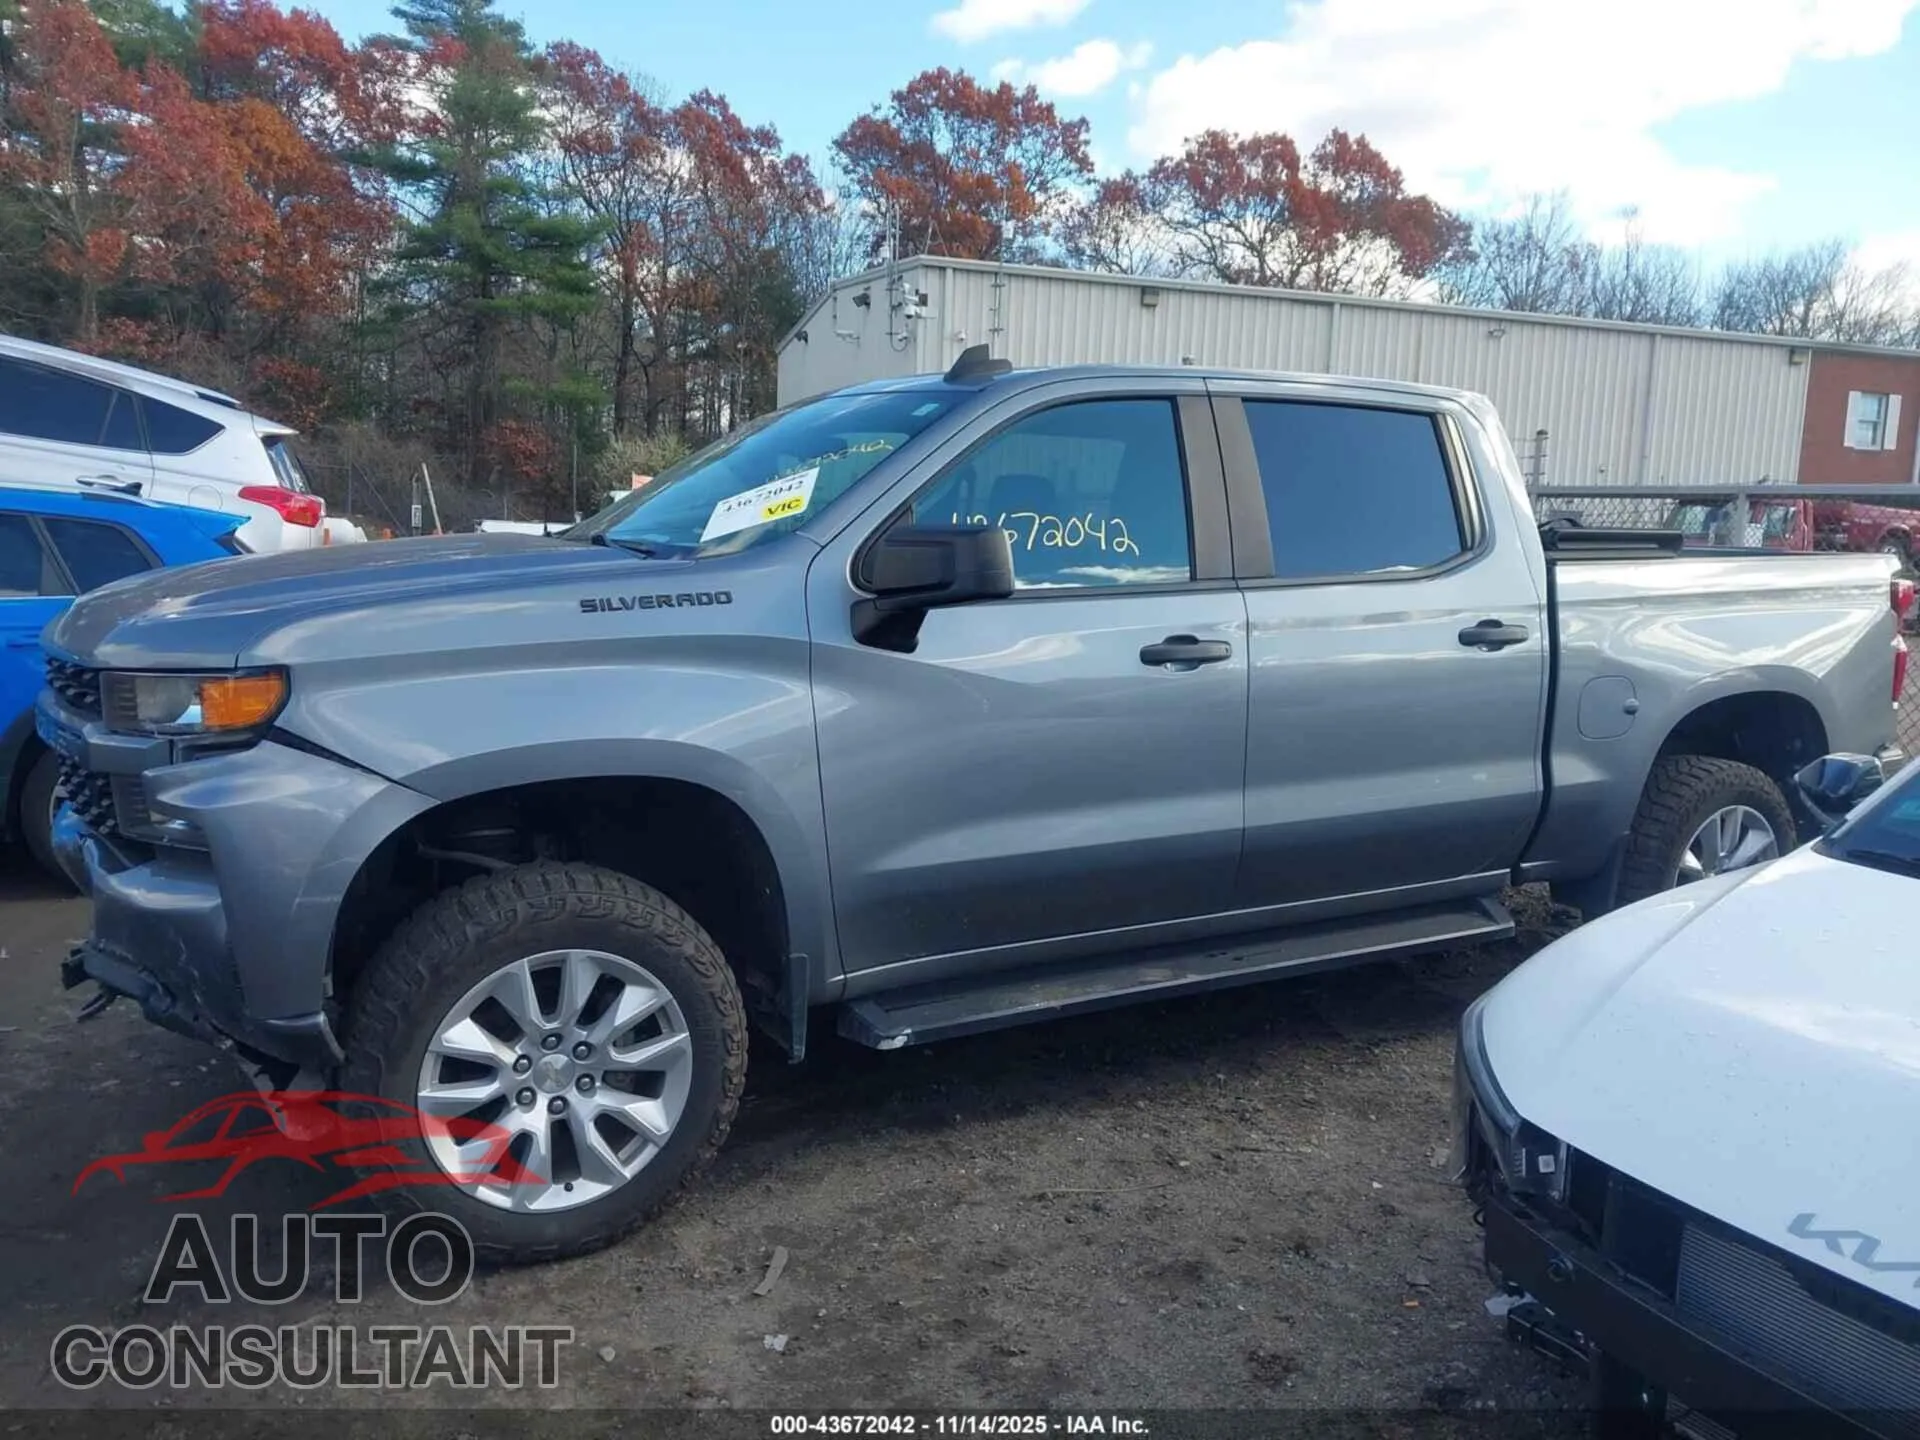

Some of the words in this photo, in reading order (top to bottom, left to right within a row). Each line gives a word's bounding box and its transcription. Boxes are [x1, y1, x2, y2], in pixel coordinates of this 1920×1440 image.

[766, 498, 801, 516] VIC
[951, 512, 1140, 557] 672042
[580, 590, 733, 613] SILVERADO
